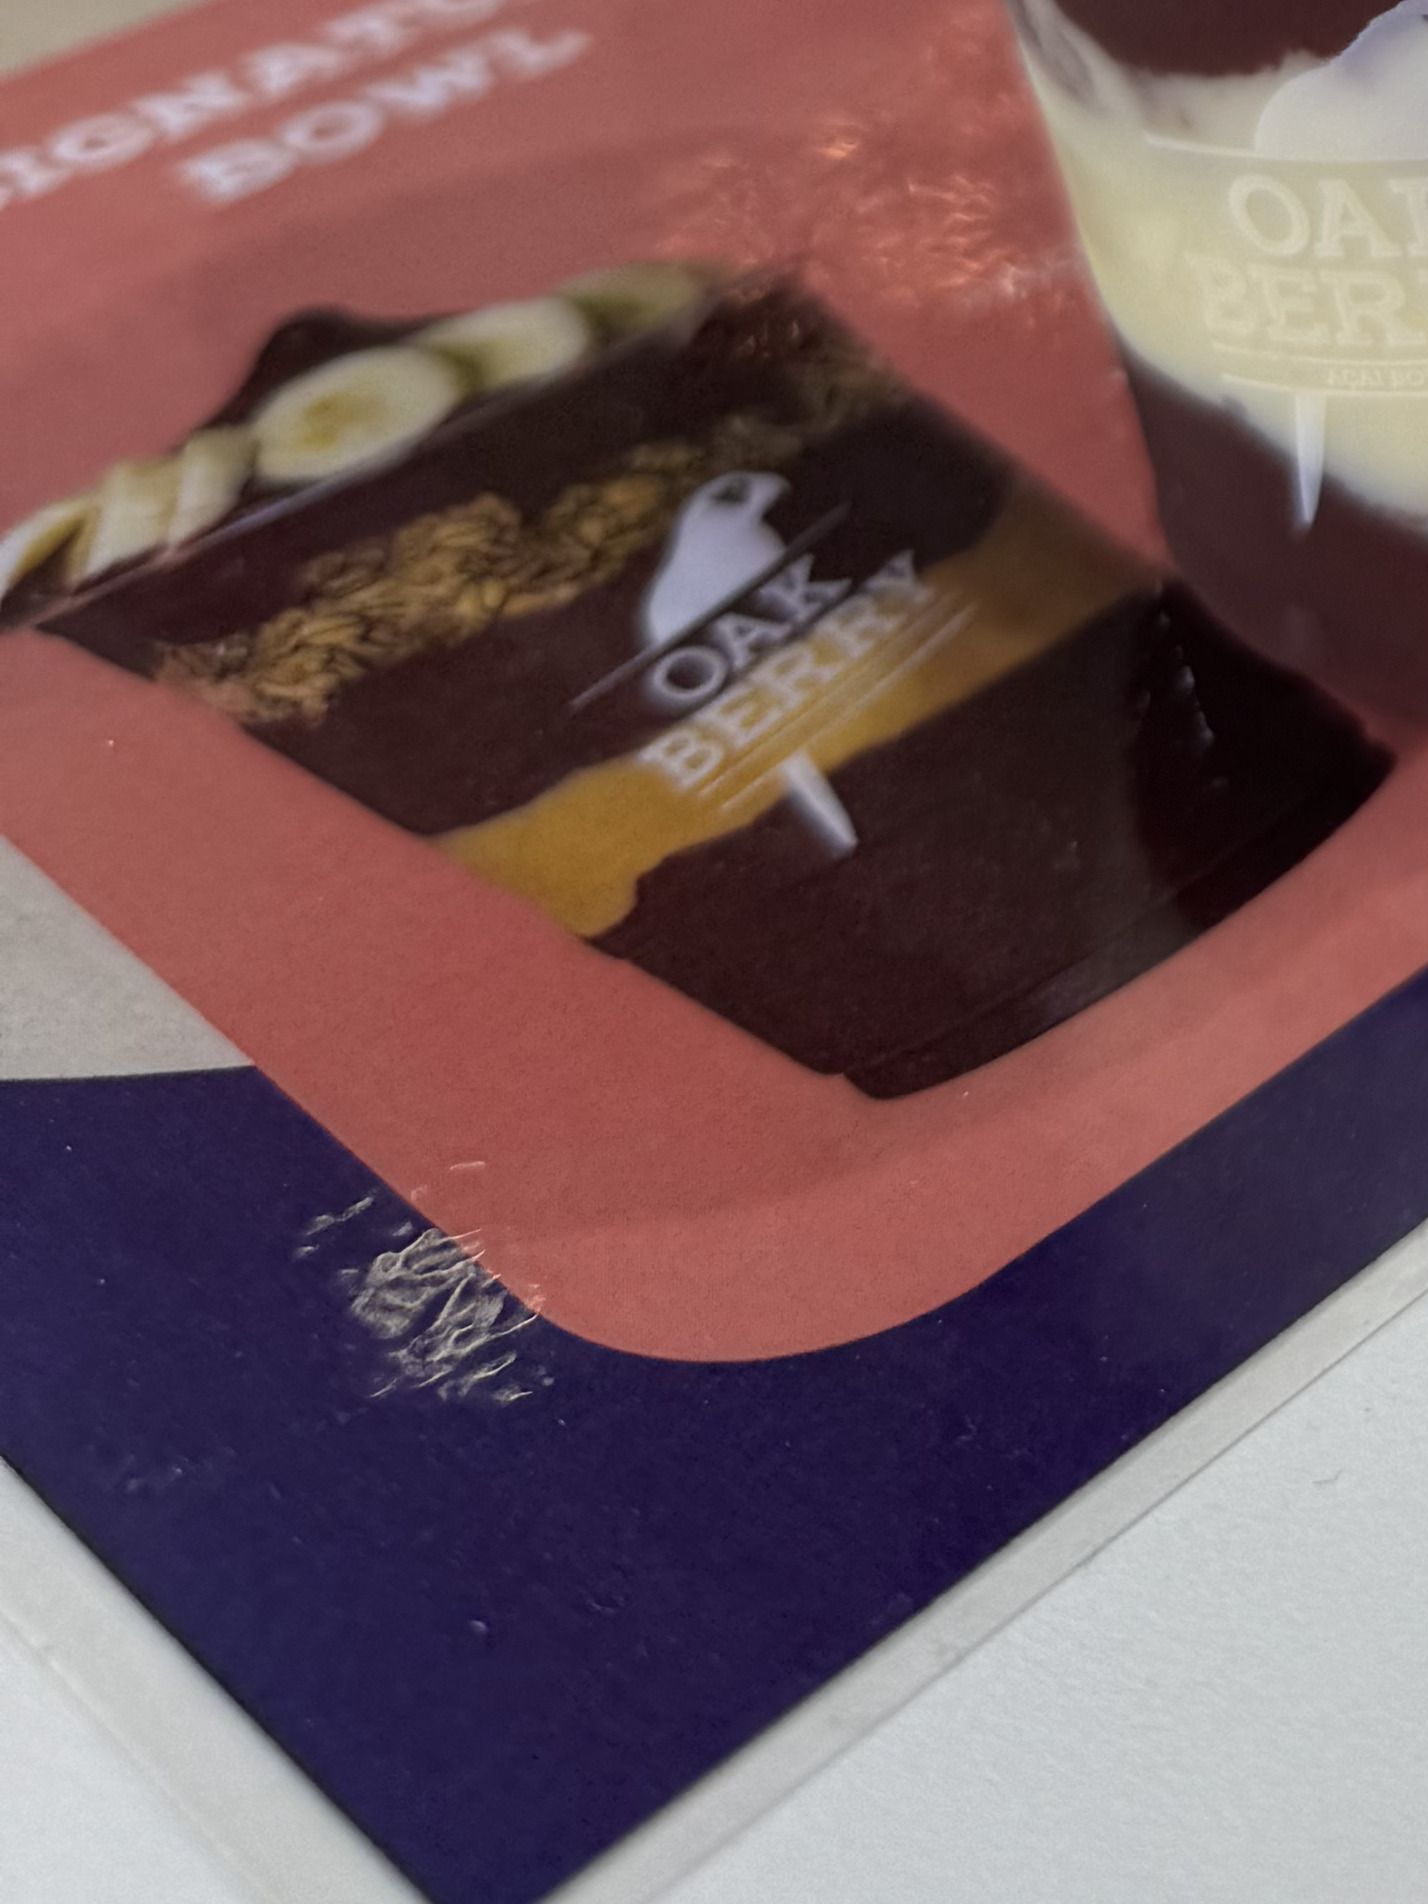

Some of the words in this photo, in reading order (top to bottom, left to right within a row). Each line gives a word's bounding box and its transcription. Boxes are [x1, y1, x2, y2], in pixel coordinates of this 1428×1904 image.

[178, 27, 592, 202] BOWL
[637, 548, 940, 790] BERRY
[650, 552, 855, 702] OAK
